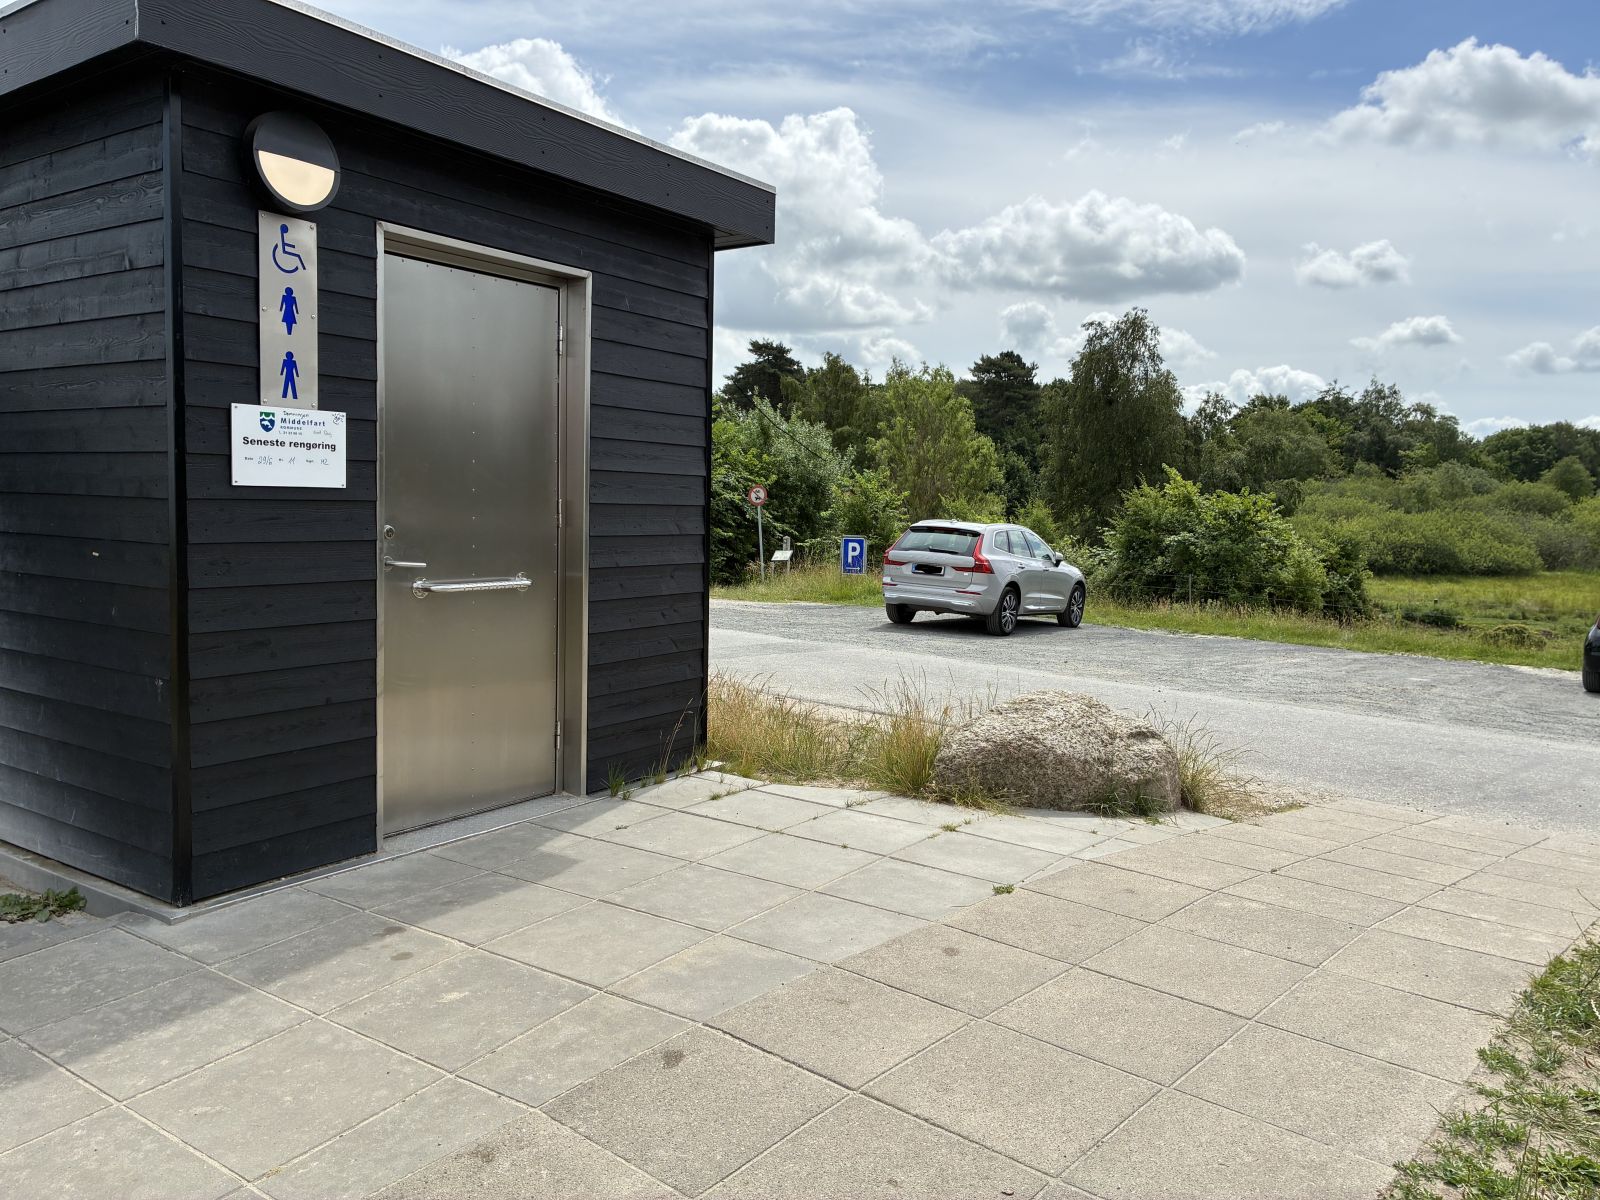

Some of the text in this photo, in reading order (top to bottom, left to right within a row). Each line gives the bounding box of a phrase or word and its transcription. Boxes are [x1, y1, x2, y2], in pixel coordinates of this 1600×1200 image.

[280, 417, 325, 427] Middelfart
[242, 436, 336, 452] Seneste rengøring
[848, 542, 861, 564] P
